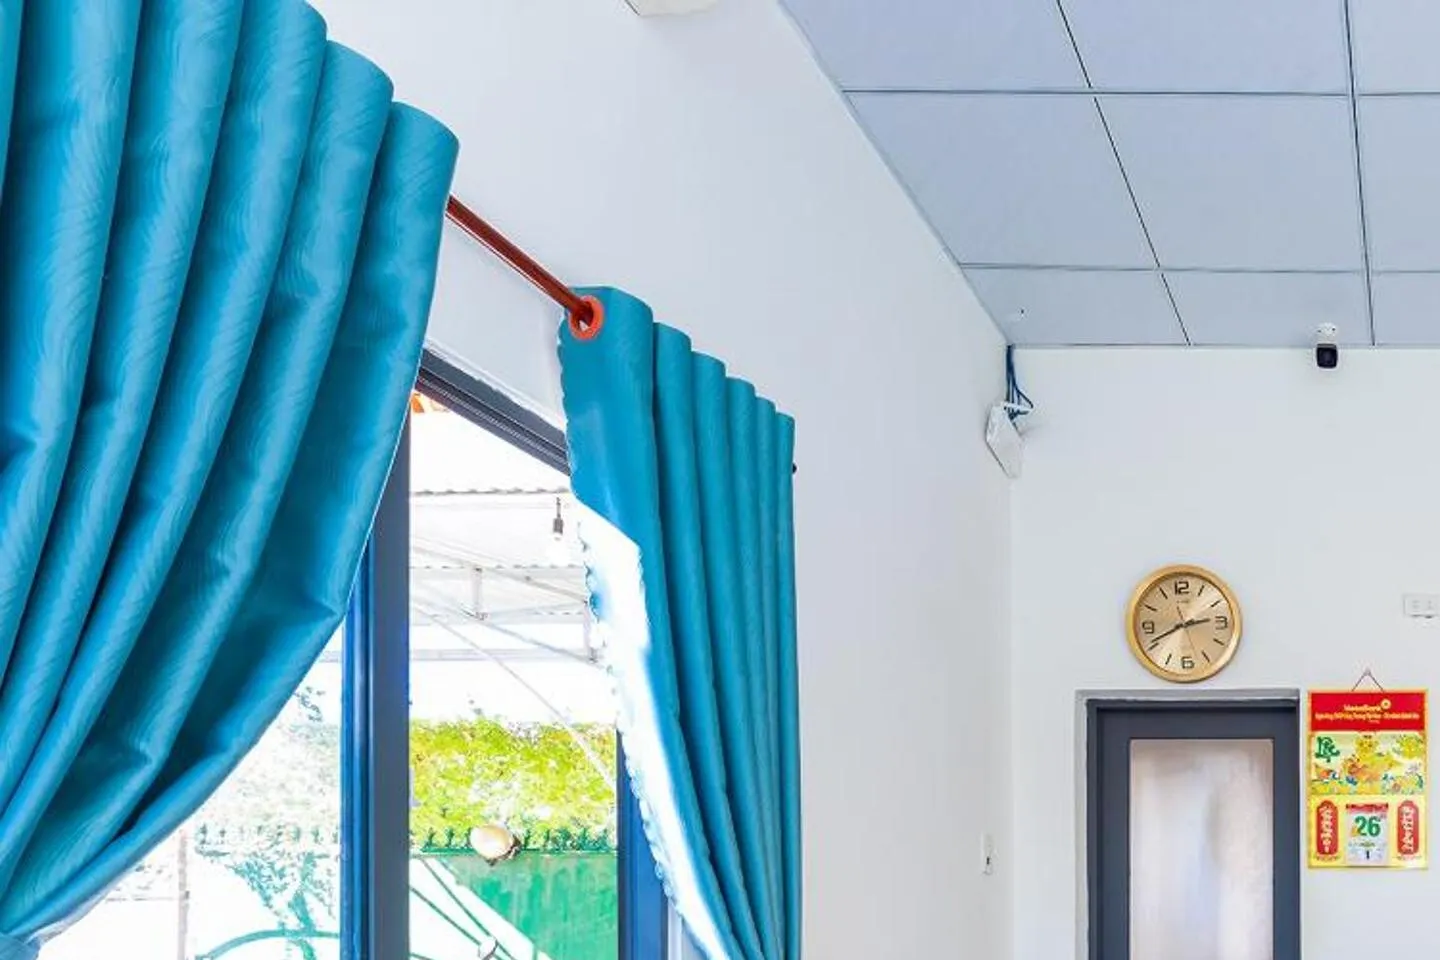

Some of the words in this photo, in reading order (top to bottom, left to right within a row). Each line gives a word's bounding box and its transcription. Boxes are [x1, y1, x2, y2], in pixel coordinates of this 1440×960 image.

[1174, 580, 1190, 595] 12
[1142, 621, 1155, 634] 9
[1214, 616, 1228, 630] 3
[1181, 656, 1195, 669] 6
[1354, 815, 1381, 837] 26
